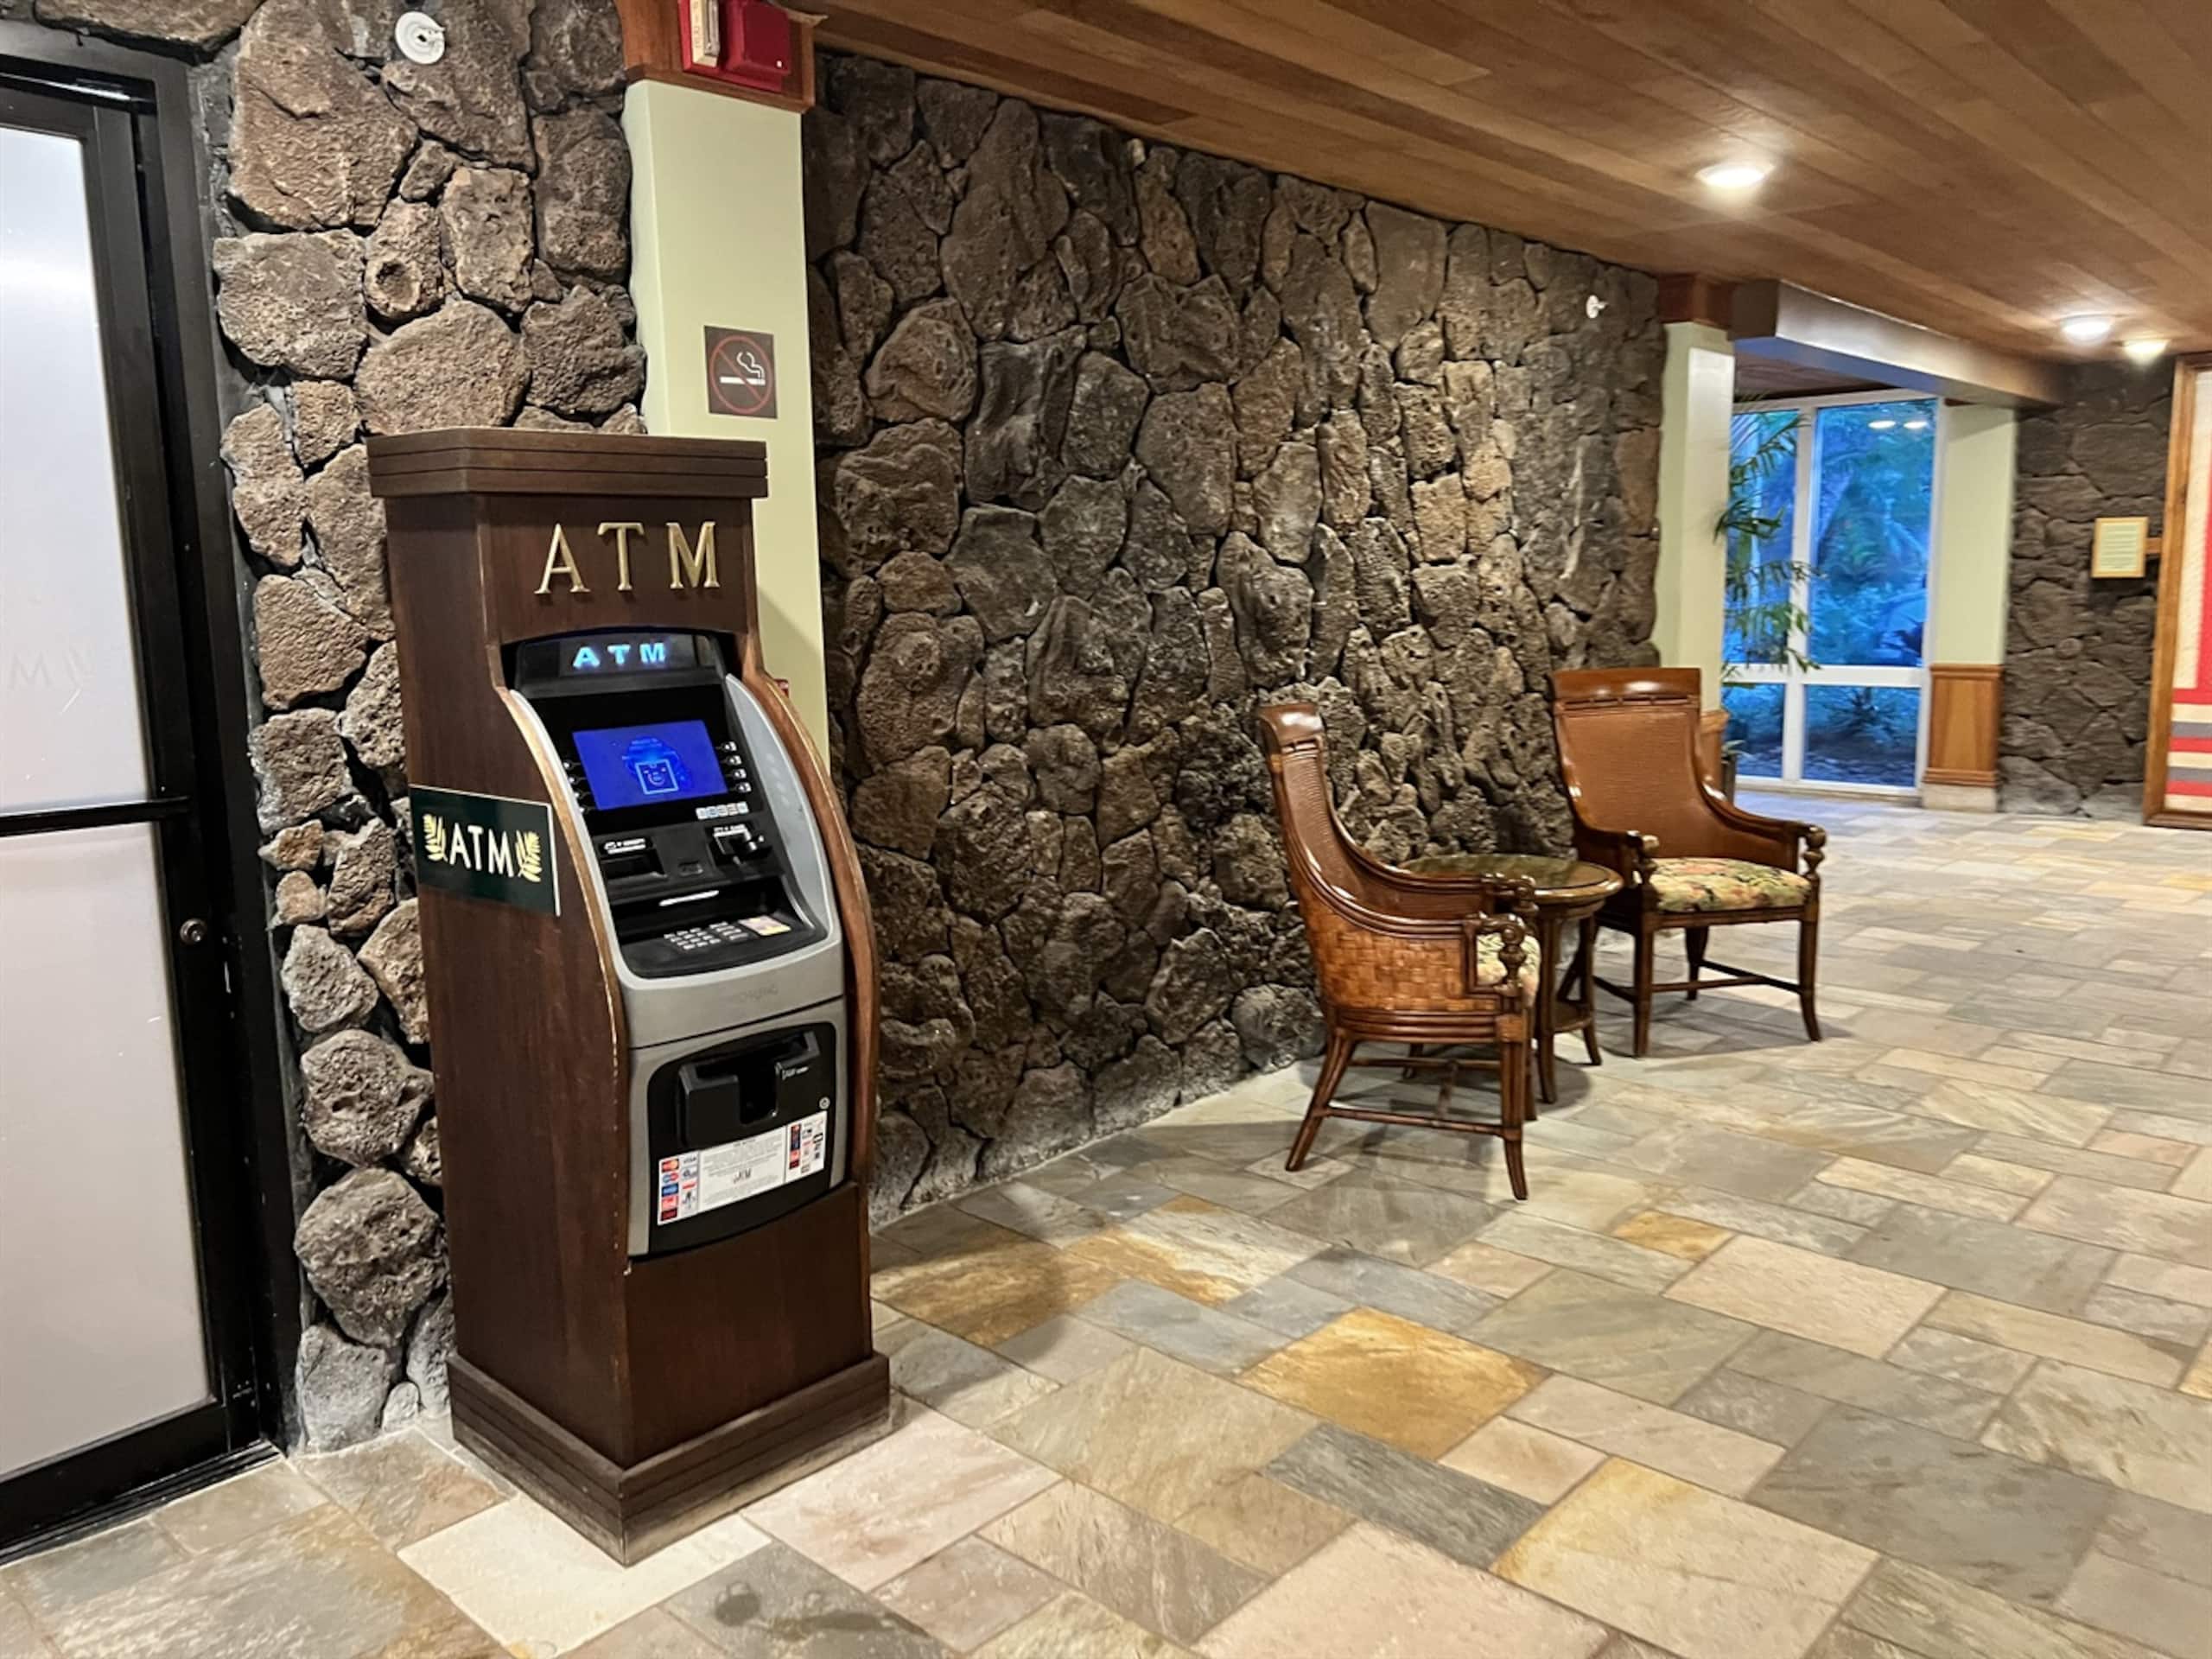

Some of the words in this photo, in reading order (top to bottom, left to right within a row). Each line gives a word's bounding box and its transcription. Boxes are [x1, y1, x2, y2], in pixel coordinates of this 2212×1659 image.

[534, 521, 720, 594] ATM
[572, 643, 665, 669] ATM
[448, 822, 514, 878] ATM
